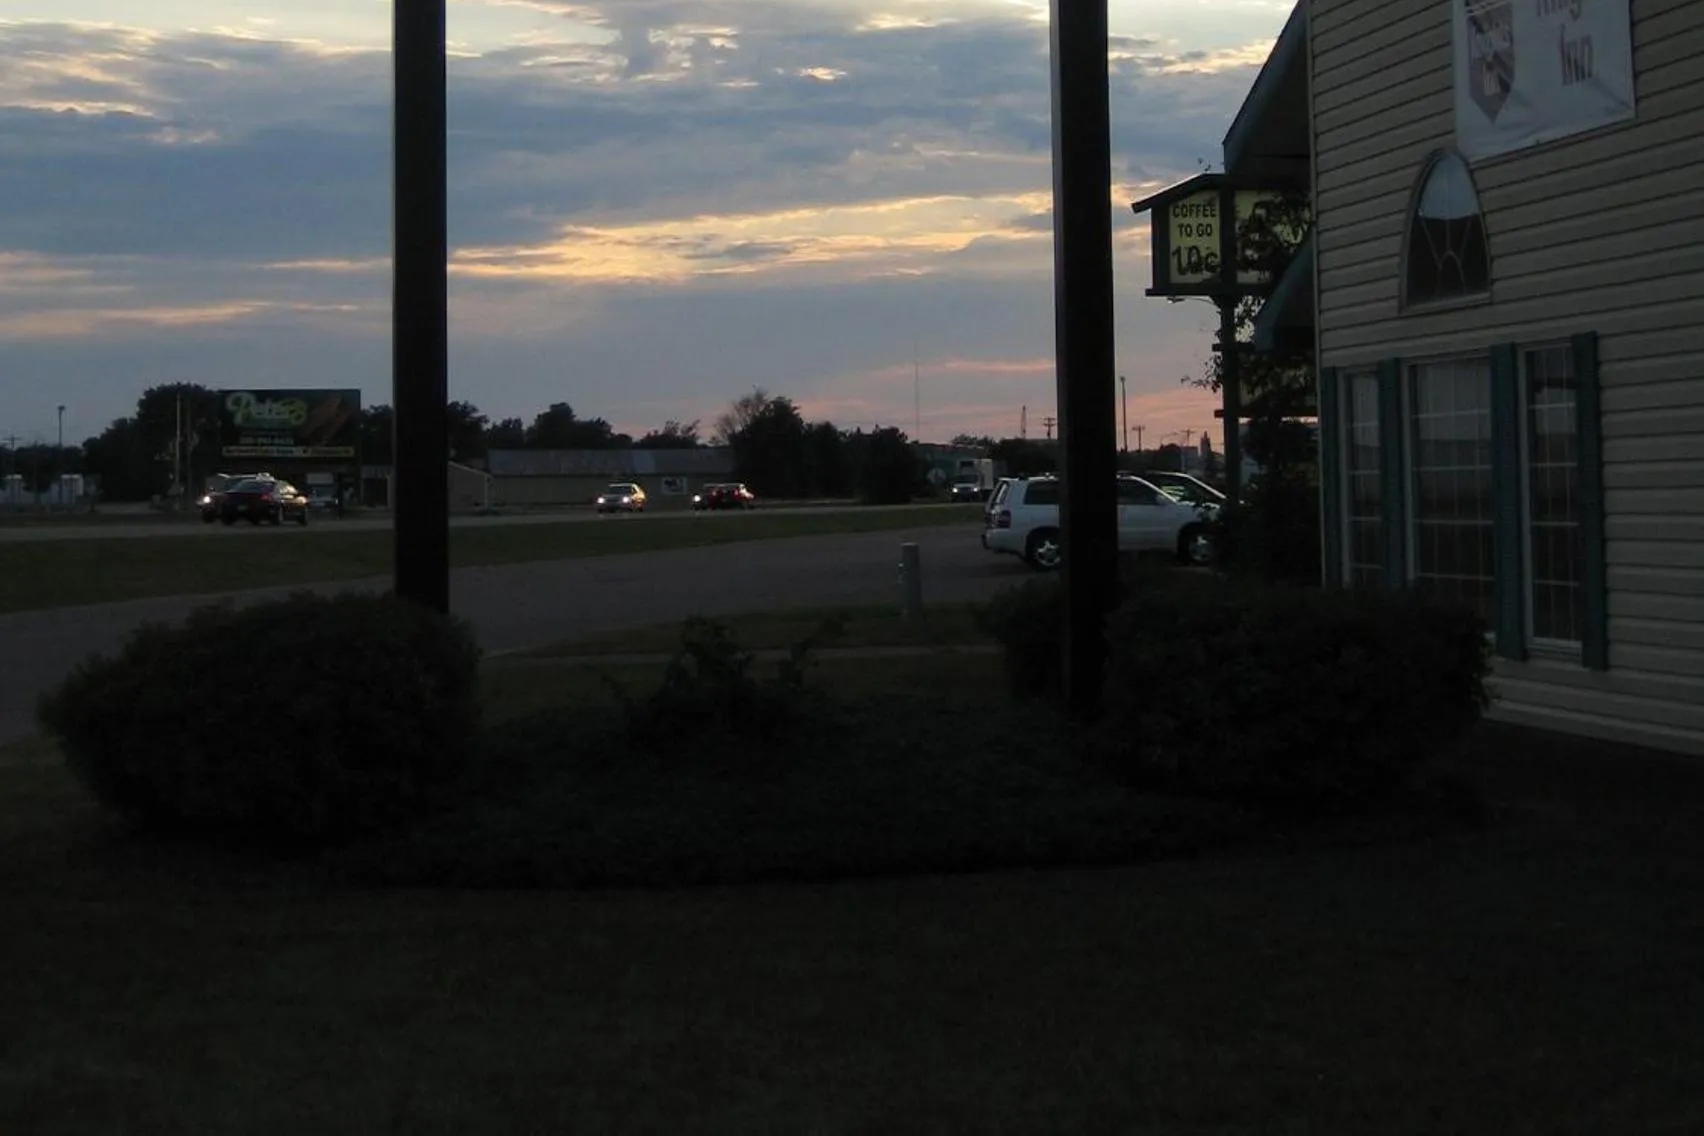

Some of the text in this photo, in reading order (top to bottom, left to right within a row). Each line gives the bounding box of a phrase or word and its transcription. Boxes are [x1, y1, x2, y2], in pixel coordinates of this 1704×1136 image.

[1560, 23, 1594, 86] Inn
[1172, 204, 1216, 218] COFFEE
[1178, 223, 1213, 238] TO GO
